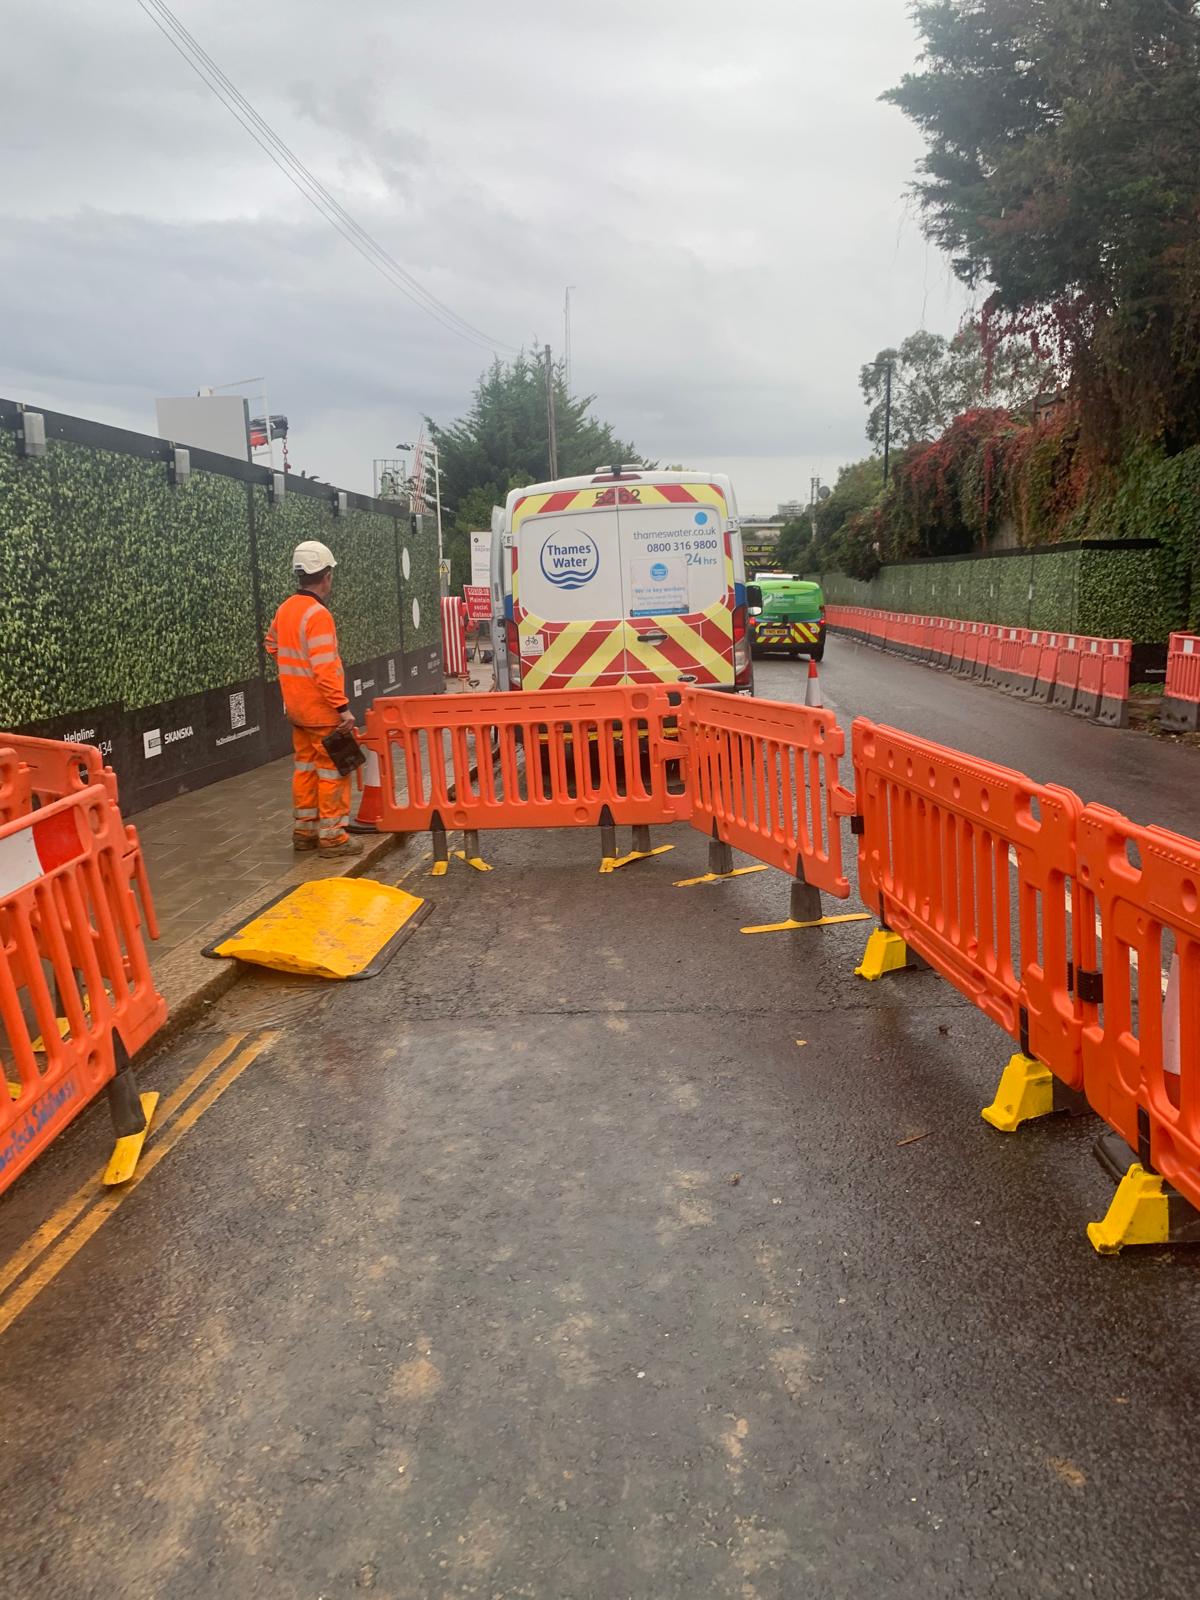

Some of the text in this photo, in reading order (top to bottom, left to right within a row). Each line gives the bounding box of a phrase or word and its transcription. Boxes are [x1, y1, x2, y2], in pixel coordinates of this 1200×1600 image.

[633, 527, 716, 541] thameswater.co.uk
[547, 545, 591, 556] Thames
[647, 540, 717, 553] 0800 316 9800
[553, 557, 587, 568] Water
[685, 552, 717, 566] 24 hrs
[63, 728, 95, 744] Helpline
[164, 726, 194, 744] SKANSKA
